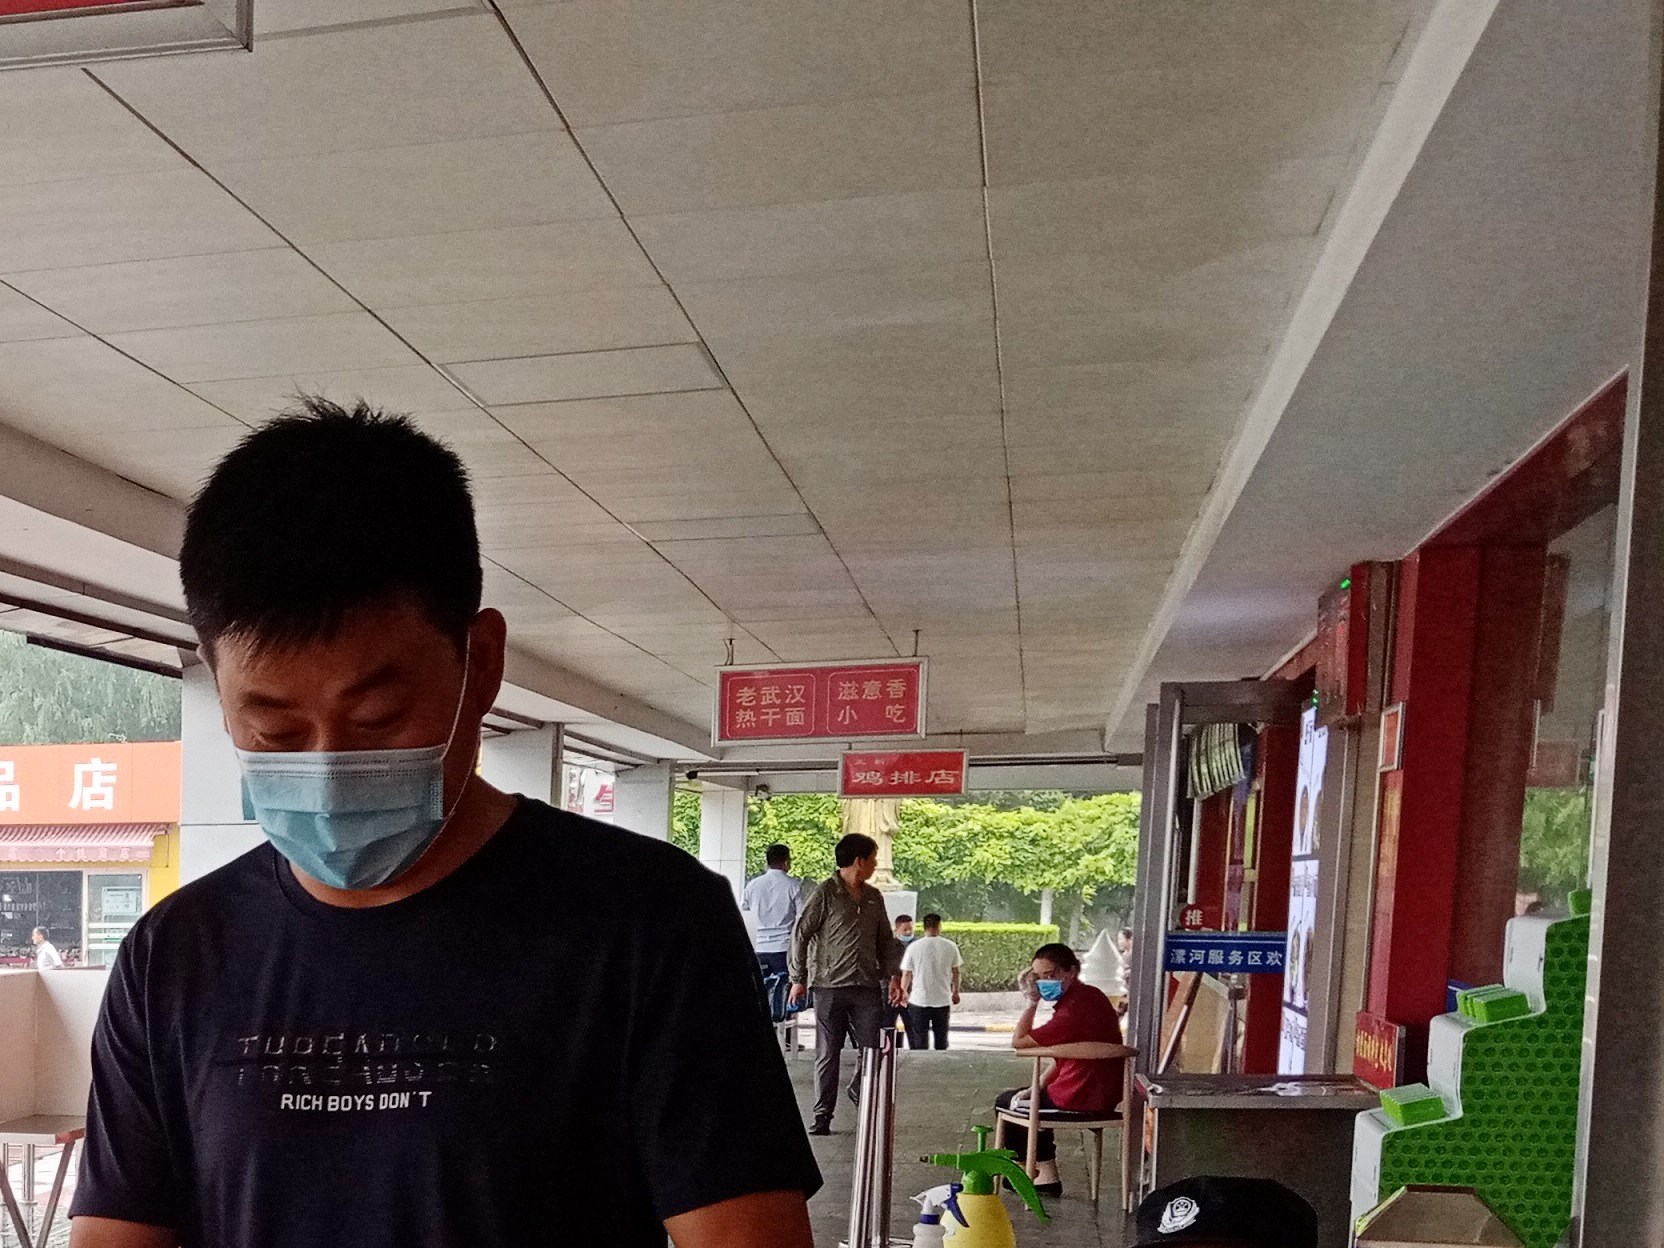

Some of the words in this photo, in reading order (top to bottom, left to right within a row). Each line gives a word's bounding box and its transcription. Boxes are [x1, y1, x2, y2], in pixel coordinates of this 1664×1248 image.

[736, 685, 807, 706] 老武汉
[736, 707, 806, 728] 热干面
[852, 769, 960, 786] 鸡排店
[1185, 909, 1203, 926] 推
[1170, 949, 1283, 966] 漯河服务区欢
[280, 1093, 323, 1111] RICH
[327, 1094, 374, 1112] BOYS
